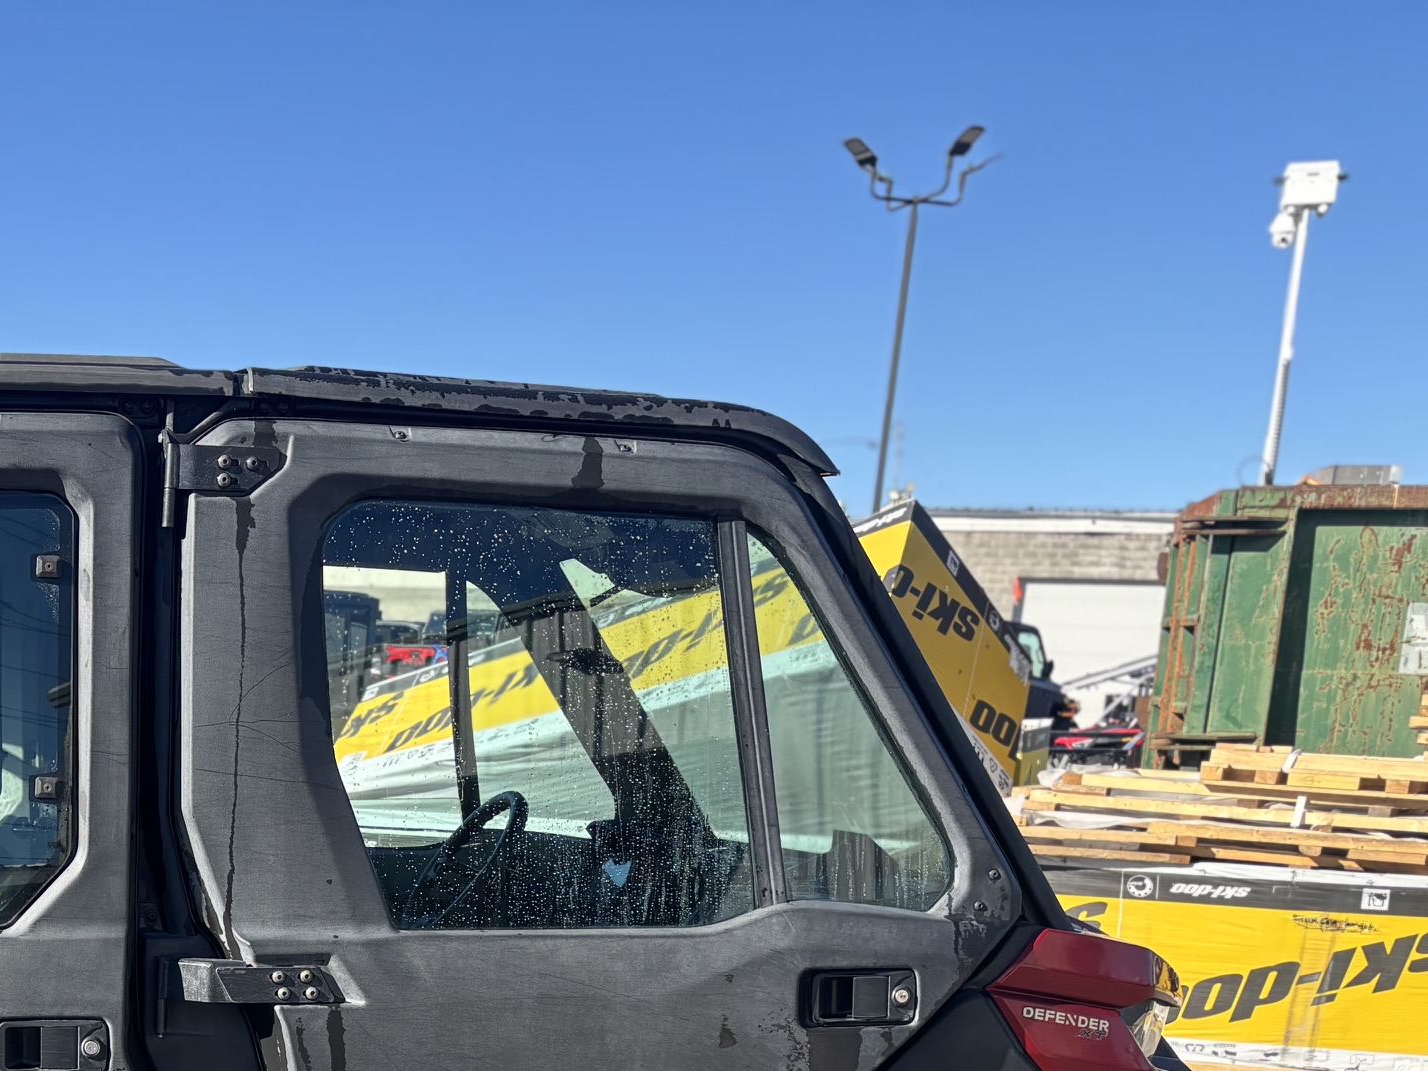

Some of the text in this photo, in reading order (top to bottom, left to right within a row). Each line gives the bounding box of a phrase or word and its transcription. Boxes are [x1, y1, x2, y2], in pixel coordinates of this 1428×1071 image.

[1170, 882, 1252, 899] ski-doo
[1022, 1006, 1110, 1033] DEFENDER
[1077, 1028, 1109, 1040] XT
